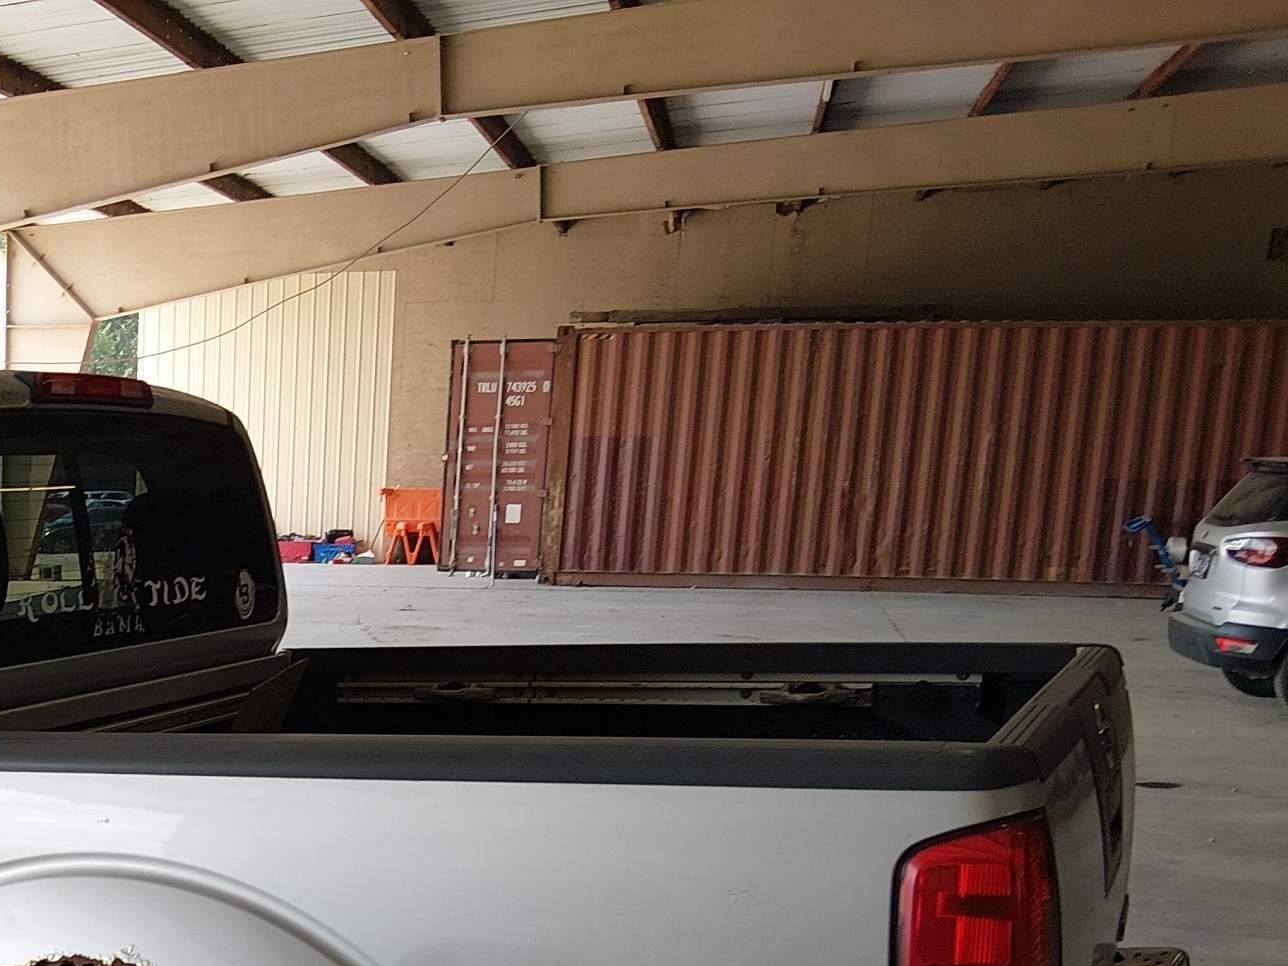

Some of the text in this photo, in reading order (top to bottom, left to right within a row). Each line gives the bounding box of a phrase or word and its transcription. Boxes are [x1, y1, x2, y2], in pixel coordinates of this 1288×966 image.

[477, 382, 498, 393] TRLU
[17, 576, 208, 623] ROLL TIDE
